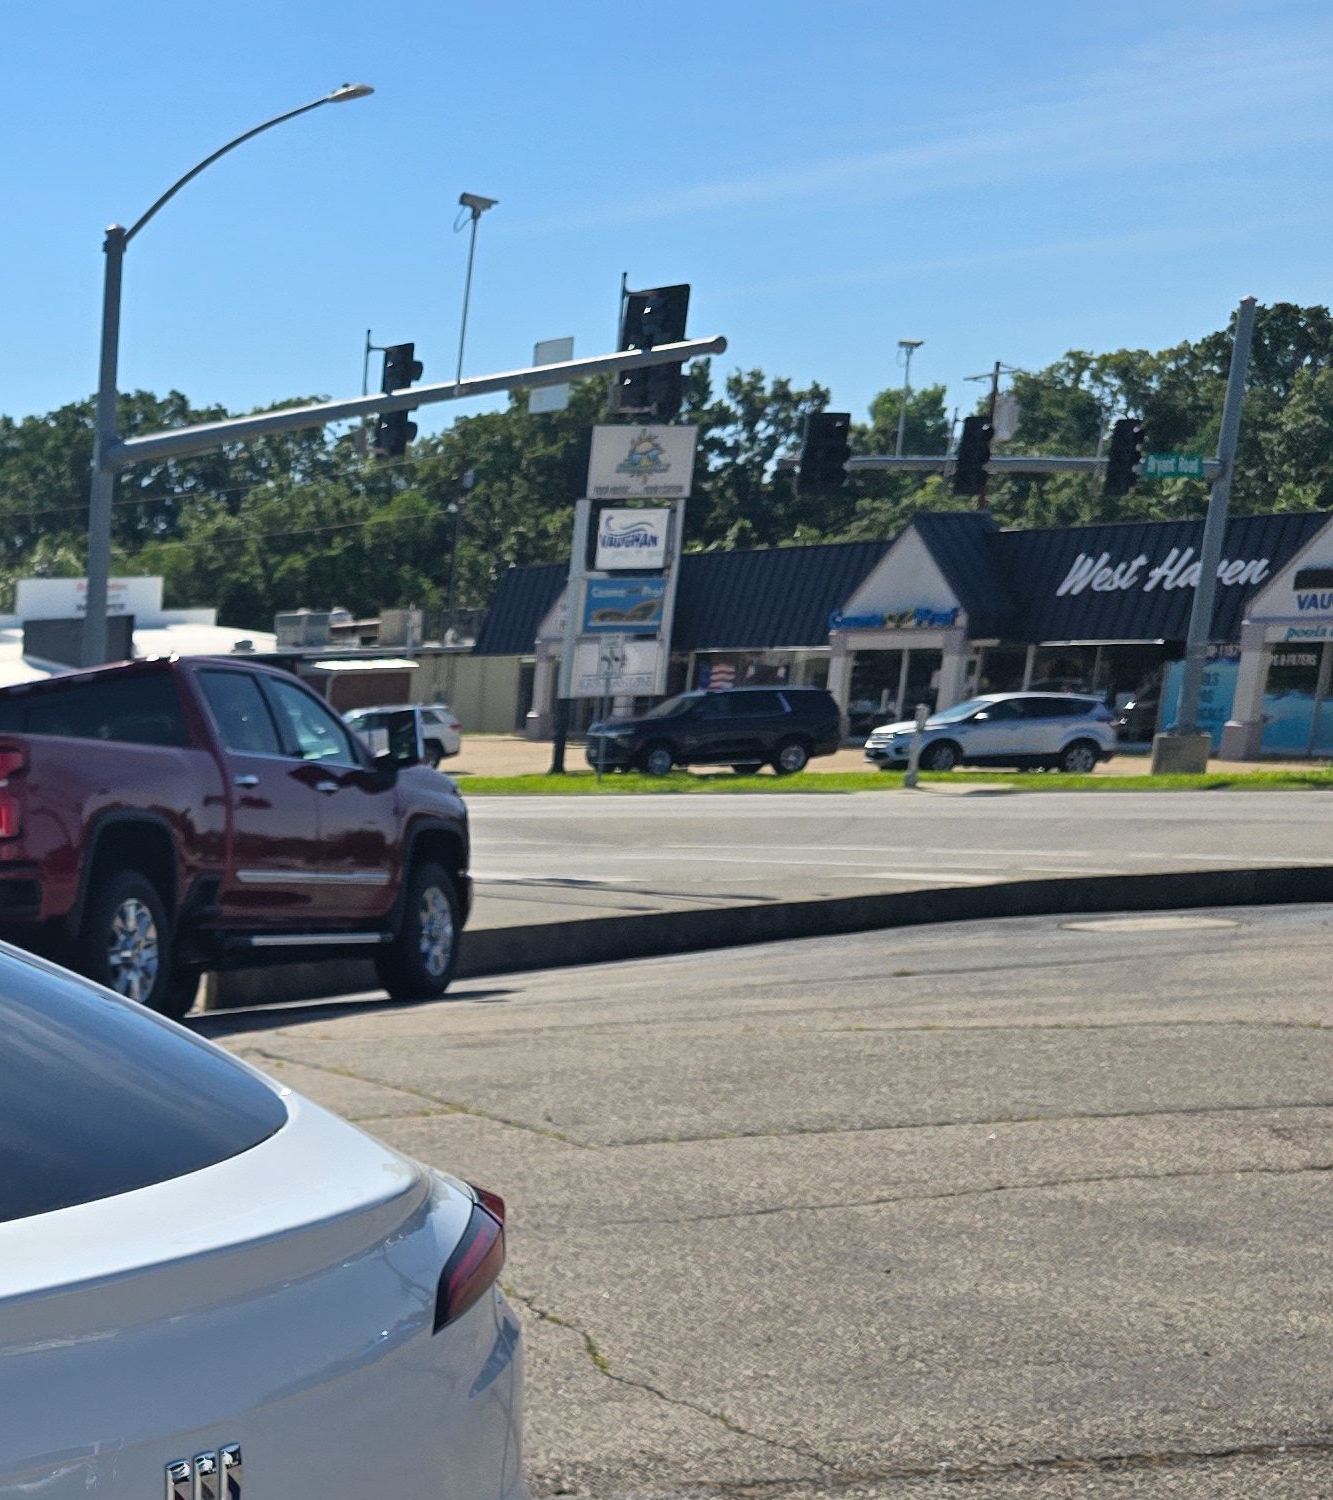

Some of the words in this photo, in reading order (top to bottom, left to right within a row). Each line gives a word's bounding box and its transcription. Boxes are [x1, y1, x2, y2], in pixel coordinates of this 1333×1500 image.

[1147, 455, 1175, 477] Bryant
[1056, 552, 1148, 596] West
[1143, 547, 1270, 592] Haven
[1297, 593, 1333, 610] VAU
